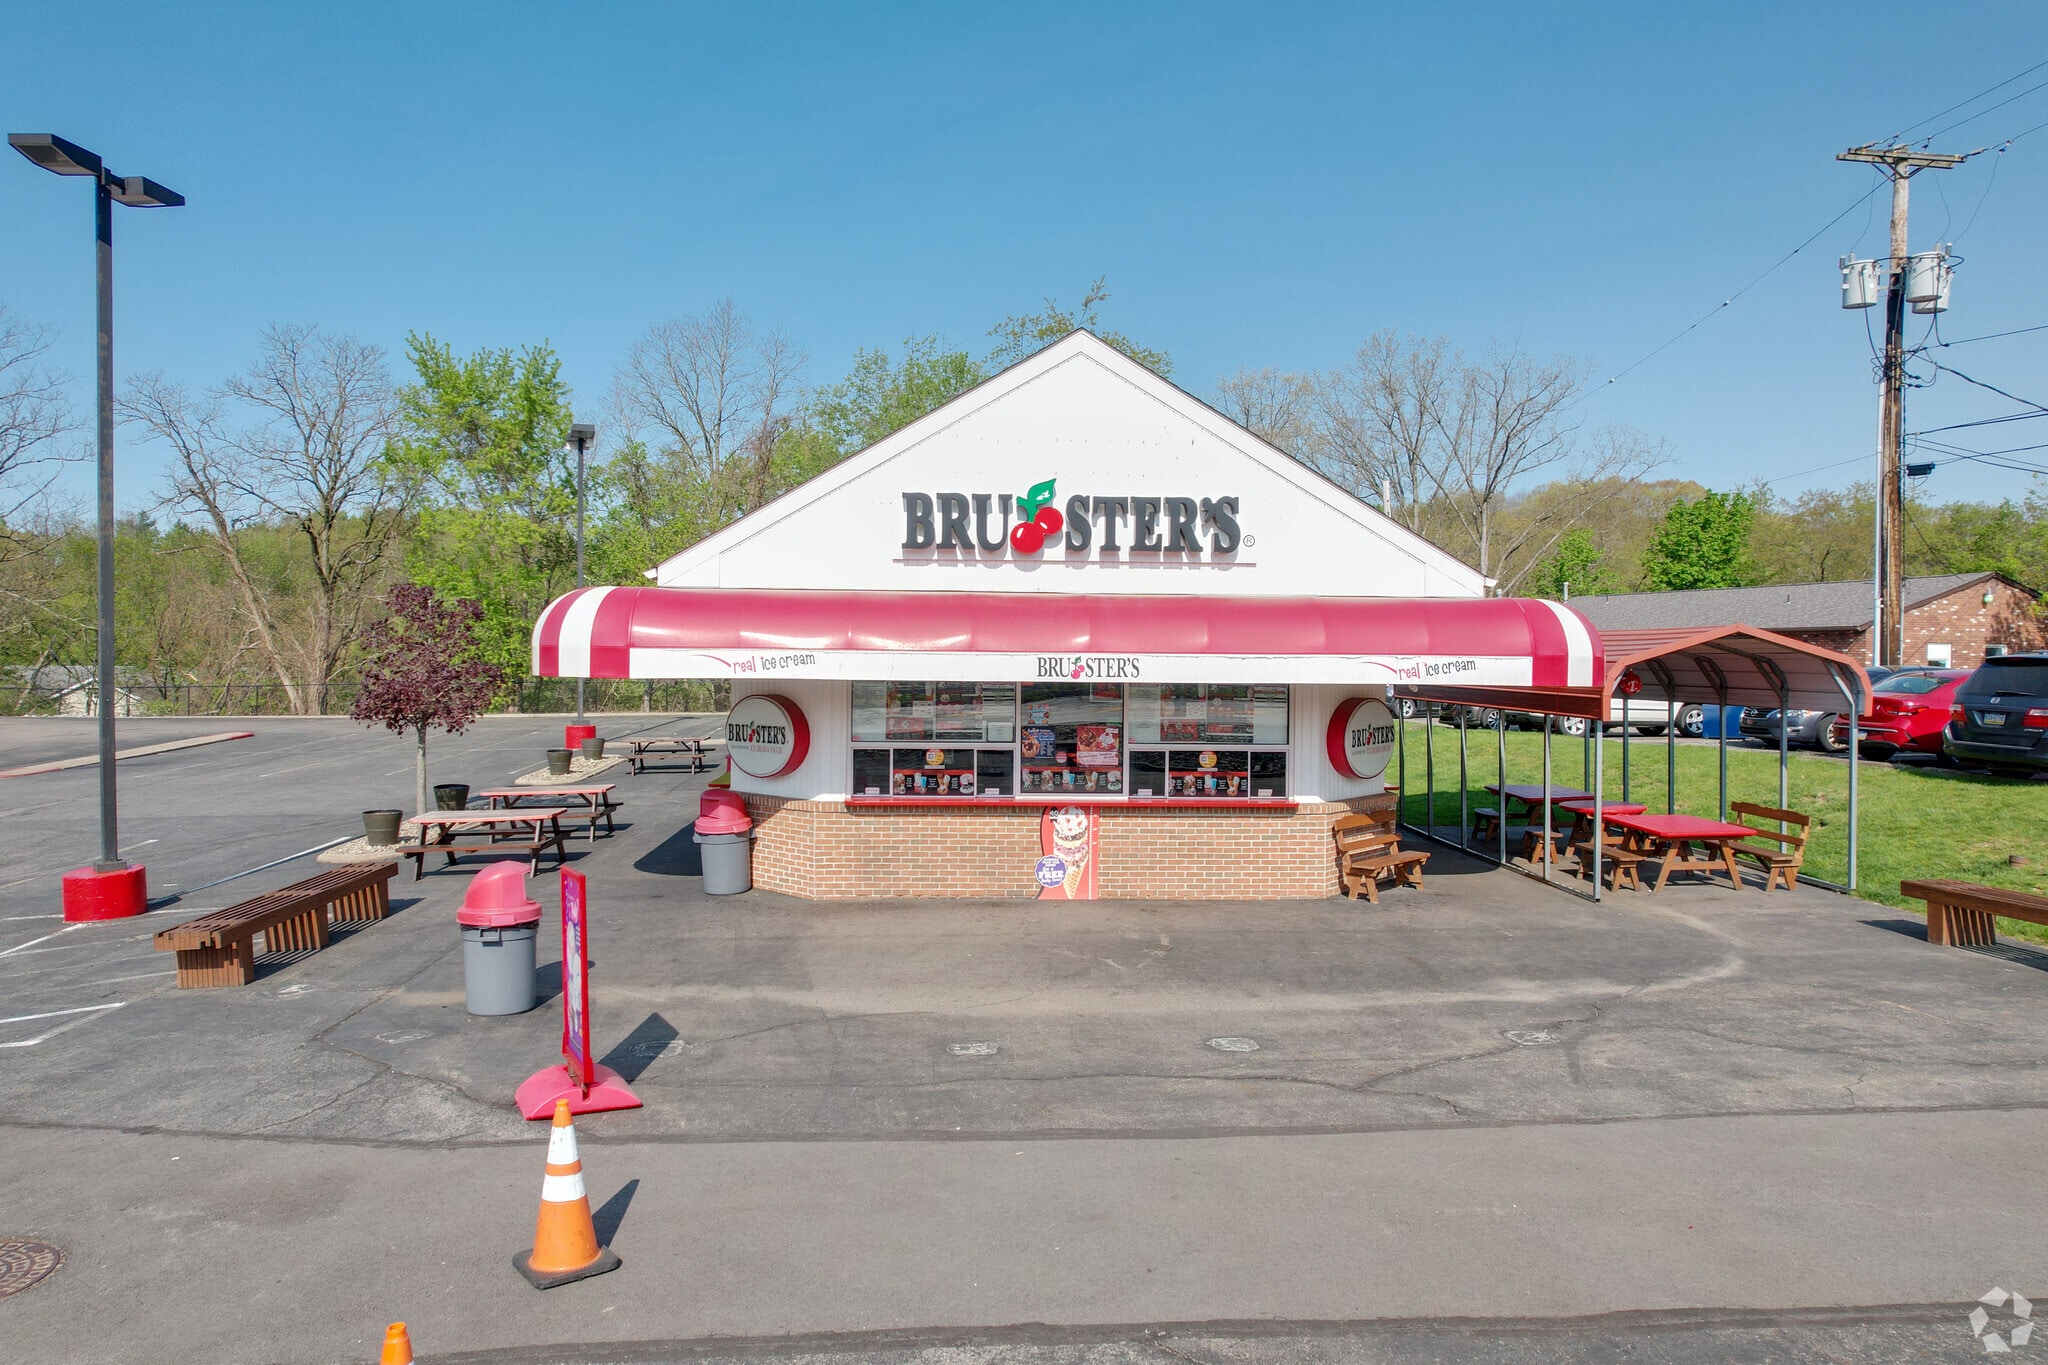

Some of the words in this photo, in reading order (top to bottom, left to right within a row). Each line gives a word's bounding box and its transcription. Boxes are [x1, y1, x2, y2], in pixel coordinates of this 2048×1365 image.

[733, 655, 757, 675] real
[760, 656, 777, 671] ice
[779, 653, 816, 669] cream
[1036, 656, 1140, 679] BRUSTER'S
[1398, 662, 1421, 681] real
[1423, 662, 1440, 677] ice
[1441, 659, 1477, 675] cream
[728, 723, 786, 745] BRUSTER'S
[1038, 870, 1064, 880] FREE
